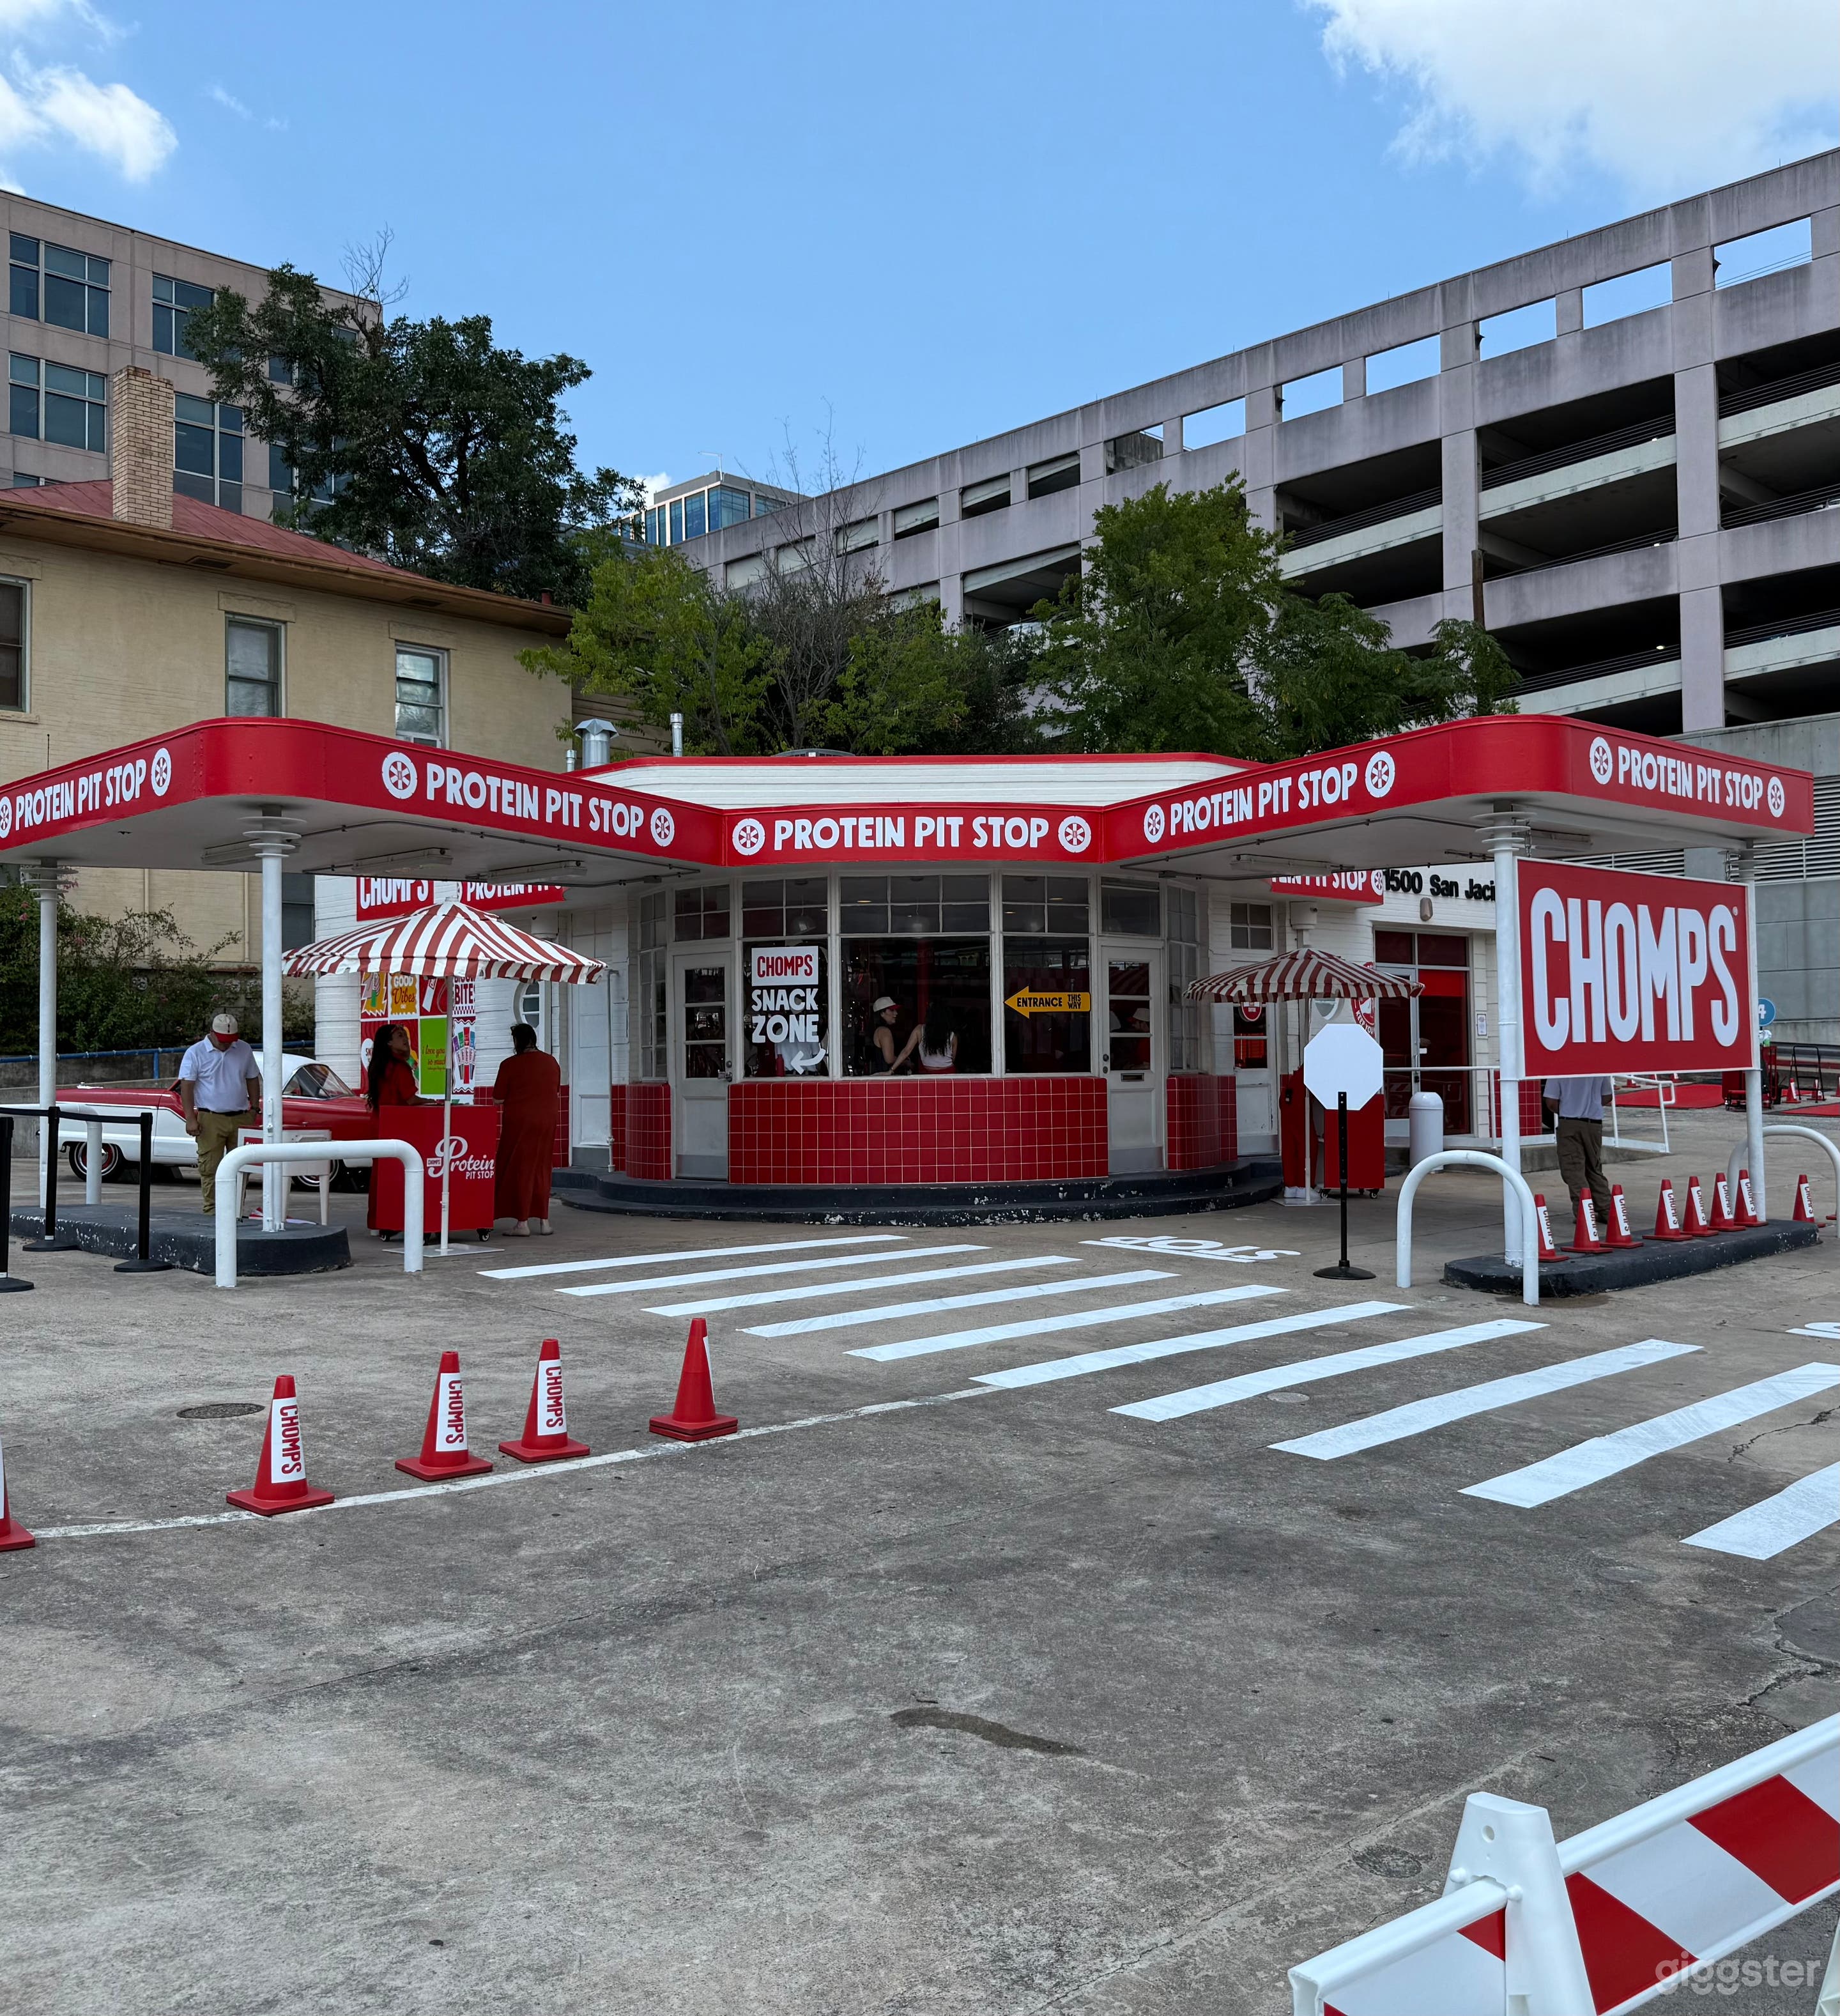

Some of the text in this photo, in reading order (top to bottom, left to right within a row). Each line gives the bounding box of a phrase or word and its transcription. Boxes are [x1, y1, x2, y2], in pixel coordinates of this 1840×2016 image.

[1618, 746, 1763, 810] PROTEIN PIT STOP
[15, 758, 146, 831] PROTEIN PIT STOP
[426, 762, 644, 838] PROTEIN PIT STOP
[1170, 762, 1358, 836] PROTEIN PIT STOP
[774, 816, 1049, 851] PROTEIN PIT STOP
[1383, 868, 1423, 894] 1500
[1430, 874, 1459, 897] San
[394, 976, 413, 987] GOOD
[757, 954, 813, 978] CHOMPS
[1530, 887, 1739, 1051] CHOMPS
[392, 987, 415, 1004] Vibes
[454, 983, 475, 1004] BITE
[751, 988, 818, 1012] SNACK
[1016, 997, 1062, 1008] ENTRANCE
[1068, 994, 1081, 1002] THIS
[752, 1014, 819, 1043] ZONE
[428, 1136, 495, 1178] Protein
[466, 1171, 494, 1180] PIT STOP
[445, 1380, 464, 1445] CHOMPS
[545, 1366, 564, 1428] CHOMPS
[280, 1404, 302, 1475] CHOMPS
